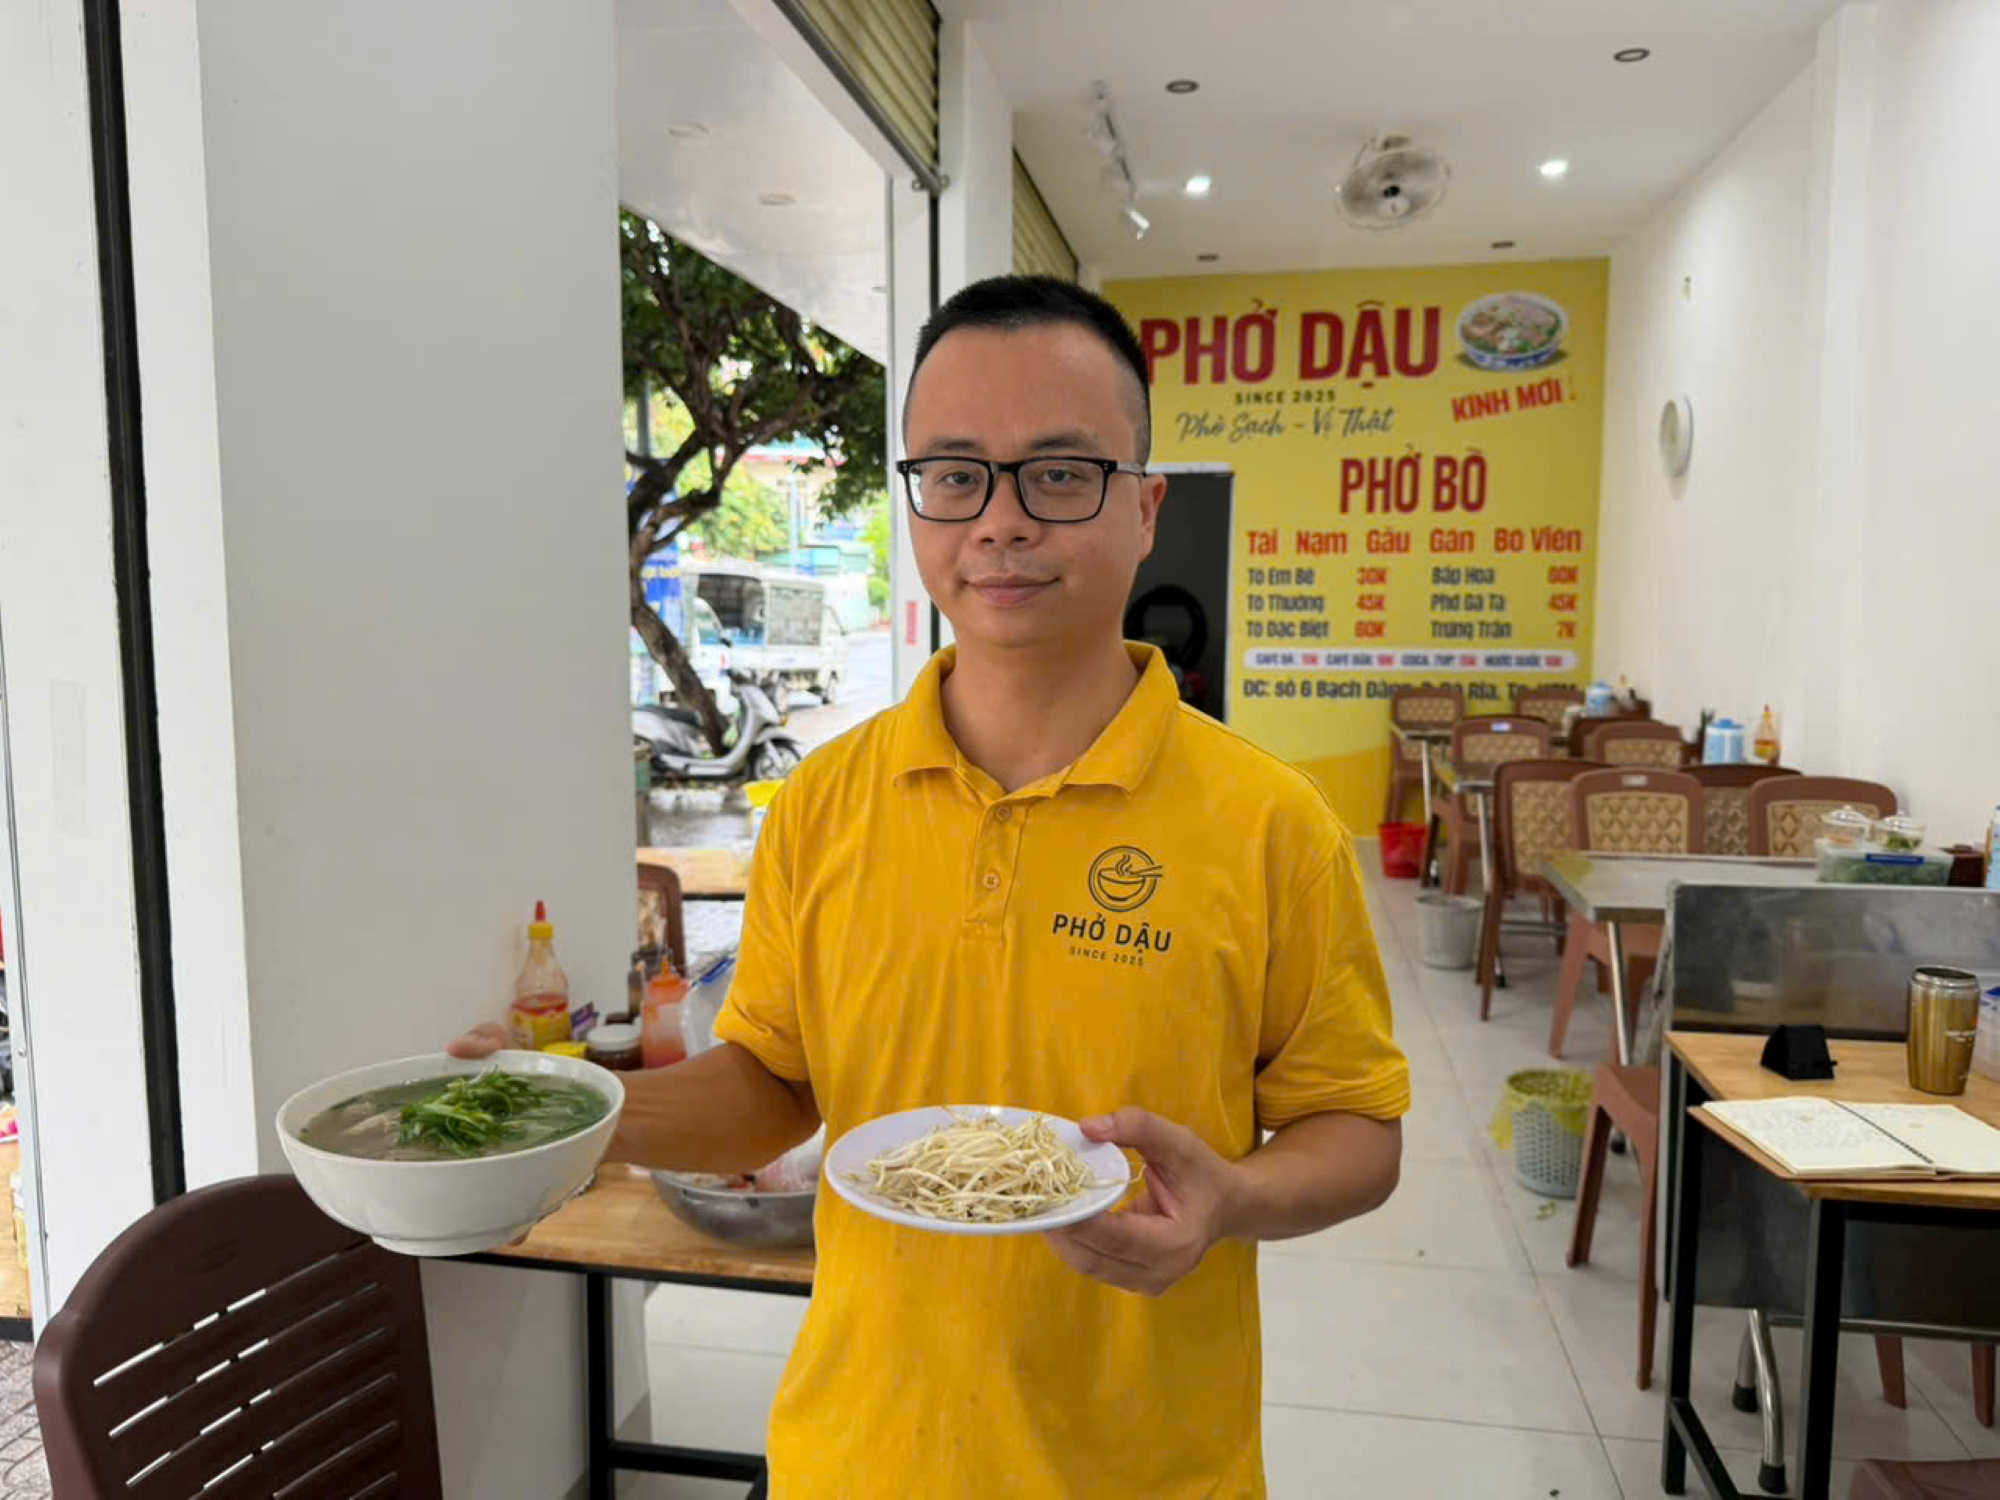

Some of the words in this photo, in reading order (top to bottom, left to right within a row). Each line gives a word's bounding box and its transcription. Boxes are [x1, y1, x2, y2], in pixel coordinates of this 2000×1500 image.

[1140, 297, 1278, 386] PHỞ
[1299, 299, 1441, 389] DẬU
[1235, 391, 1284, 405] SINCE
[1292, 390, 1336, 403] 2025
[1339, 442, 1422, 514] PHỞ
[1052, 912, 1107, 941] PHỞ
[1114, 922, 1172, 954] DẬU
[1069, 945, 1106, 961] SINCE
[1113, 953, 1144, 967] 2025
